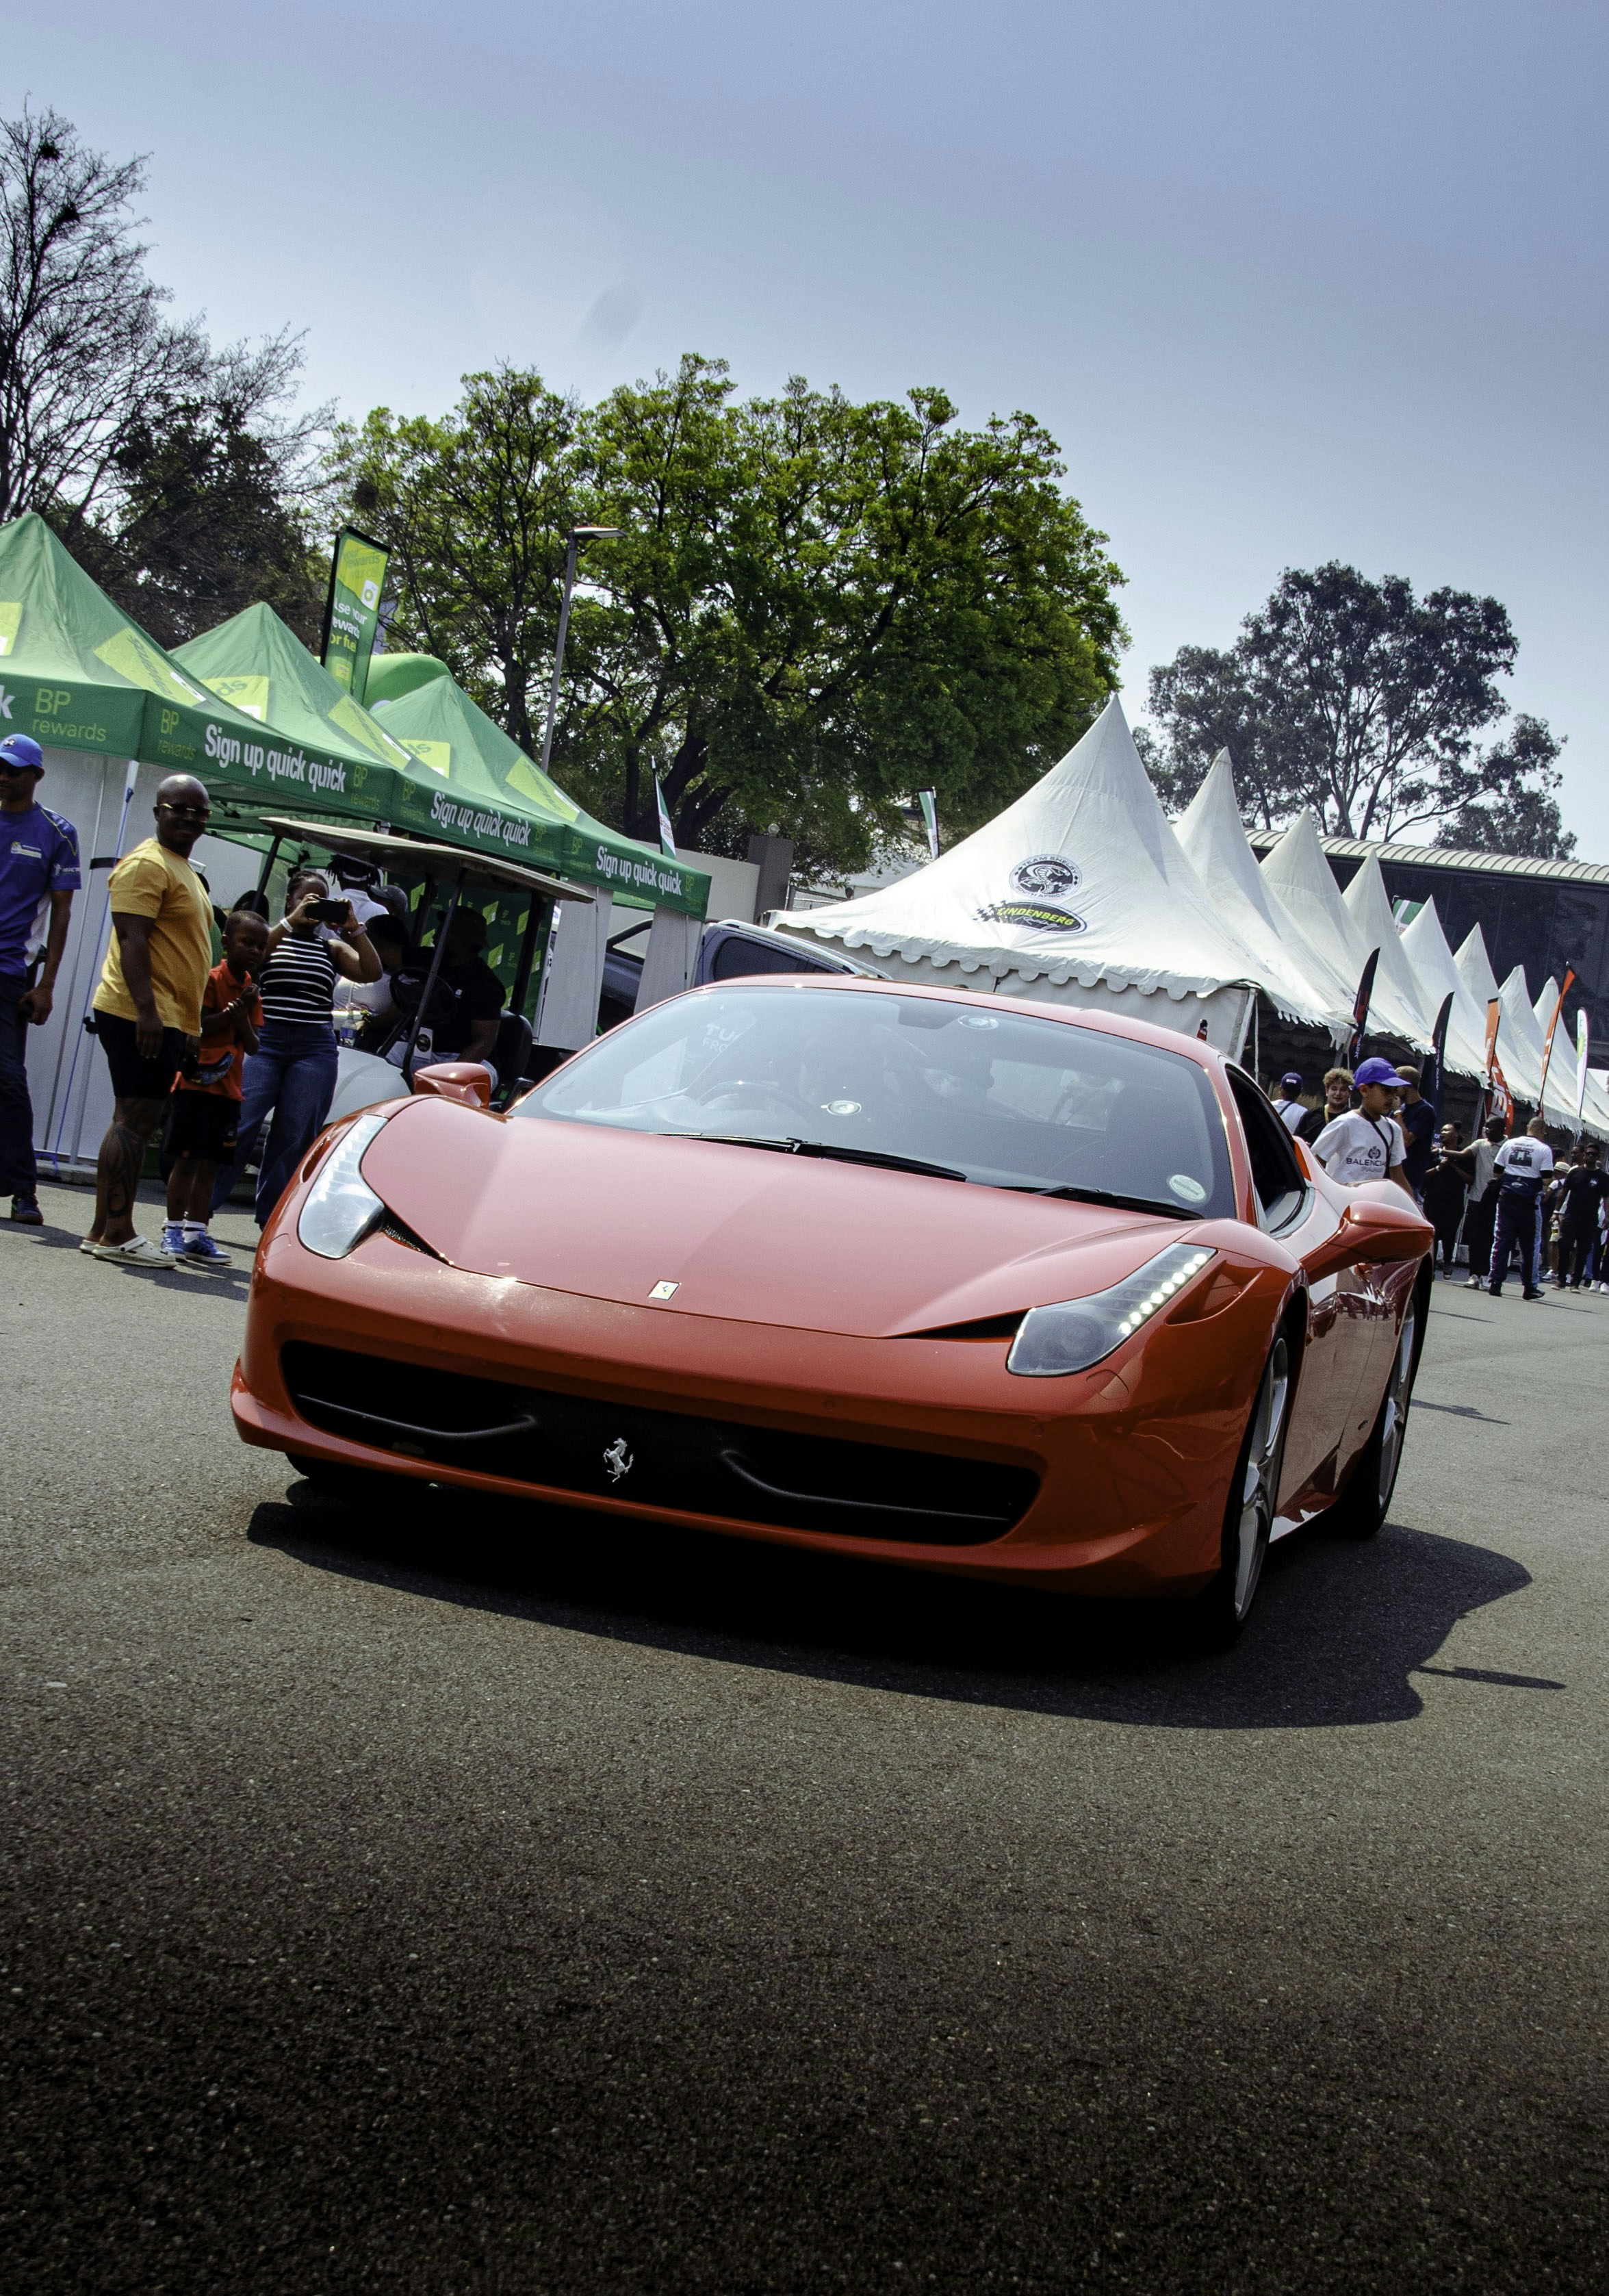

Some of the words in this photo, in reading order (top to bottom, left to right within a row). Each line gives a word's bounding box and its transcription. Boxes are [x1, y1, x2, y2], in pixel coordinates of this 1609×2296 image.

[35, 687, 71, 715] BP
[33, 719, 107, 742] rewards
[160, 709, 179, 735] BP
[157, 739, 196, 761] rewards
[205, 724, 241, 768] Sign
[244, 743, 264, 776] up
[266, 747, 307, 781] quick
[308, 758, 346, 793] quick
[353, 765, 368, 788] BP
[402, 779, 416, 801] BP
[430, 791, 458, 828] Sign
[457, 806, 474, 834] up
[474, 808, 504, 838] quick
[502, 818, 531, 847] quick
[596, 845, 617, 879] Sign
[619, 858, 632, 883] up
[633, 860, 657, 886] quick
[658, 869, 682, 896] quick
[1022, 856, 1047, 867] TEAM
[1015, 886, 1037, 897] SOUTH
[996, 907, 1075, 926] LINDENBERG
